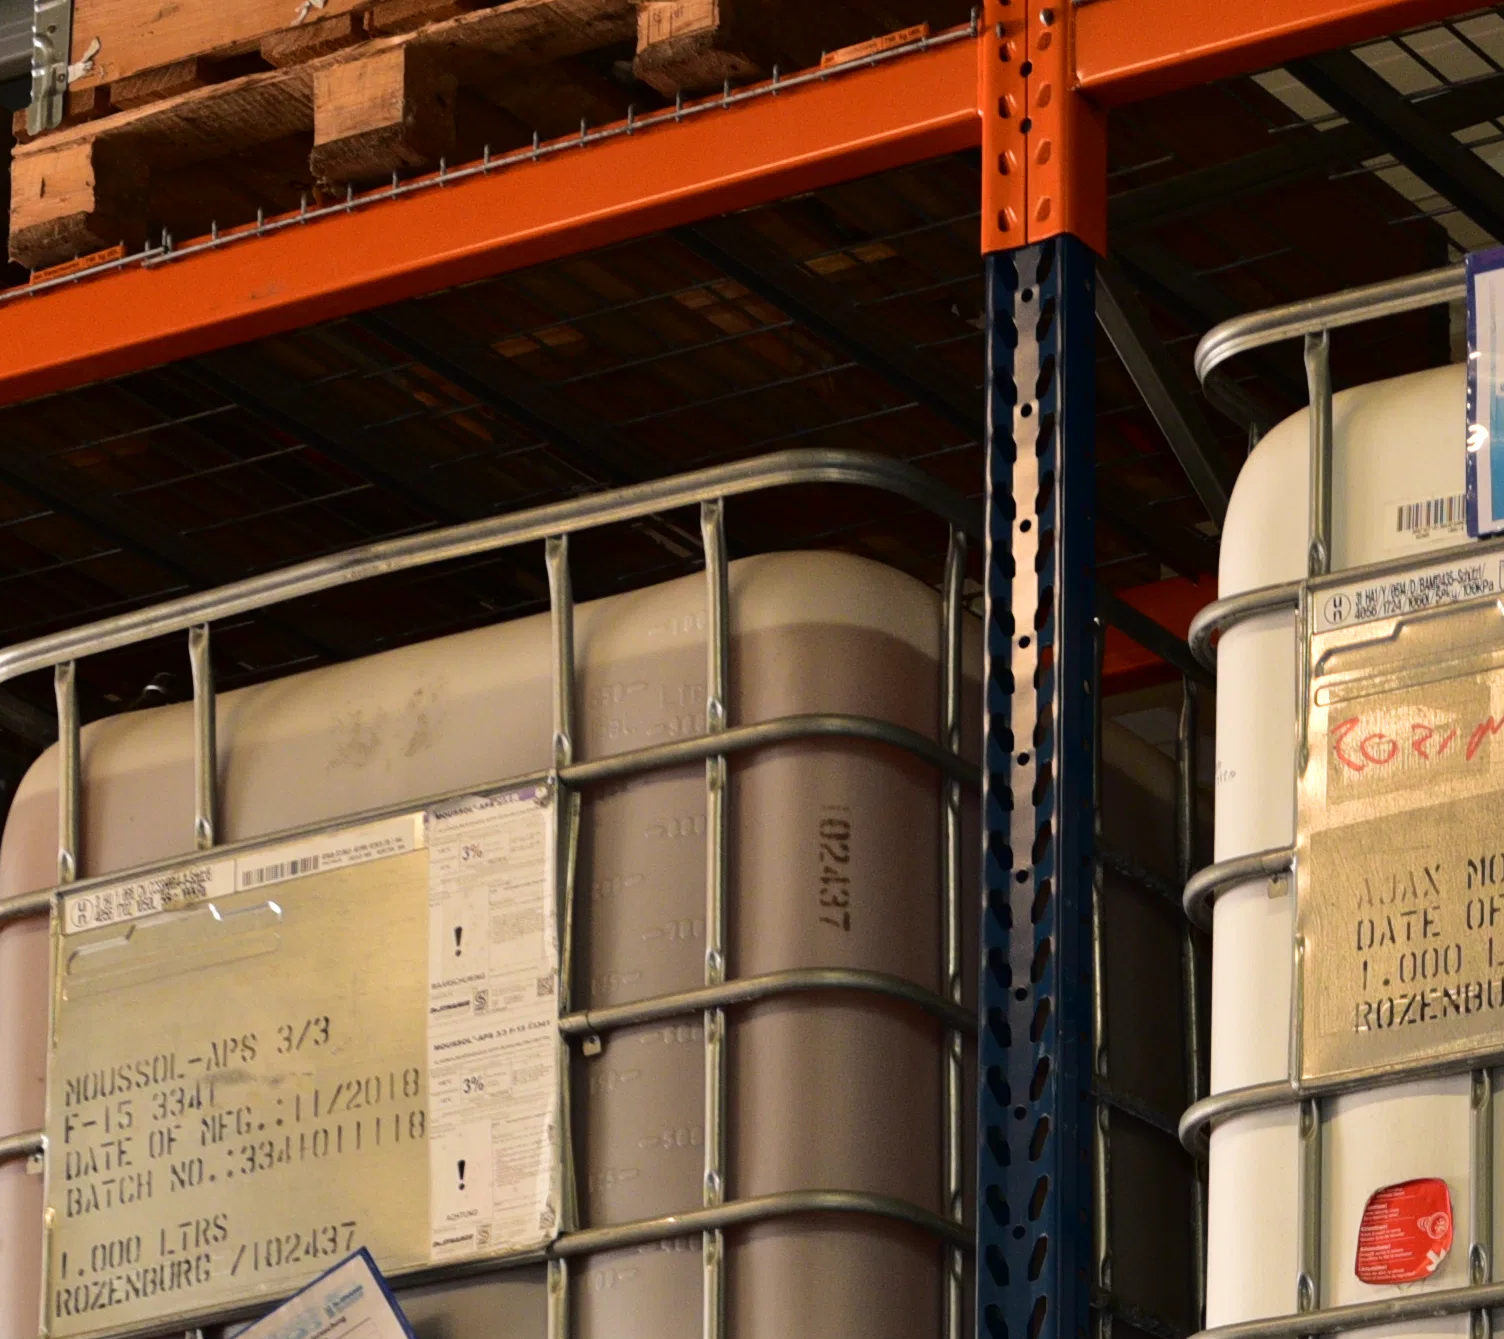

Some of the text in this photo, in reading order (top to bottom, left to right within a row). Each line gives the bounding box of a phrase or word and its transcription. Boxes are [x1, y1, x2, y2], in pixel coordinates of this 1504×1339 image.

[1357, 863, 1441, 910] AJAX
[1357, 904, 1441, 951] DATE
[1361, 944, 1462, 990] 1.000
[277, 1016, 330, 1055] 3/3
[64, 1100, 133, 1144] F-15
[65, 1140, 132, 1181] DATE
[149, 1122, 182, 1160] OF
[66, 1170, 152, 1218] BATCH
[61, 1213, 228, 1280] 1.000 LTRS
[55, 1253, 211, 1317] ROZENBURG
